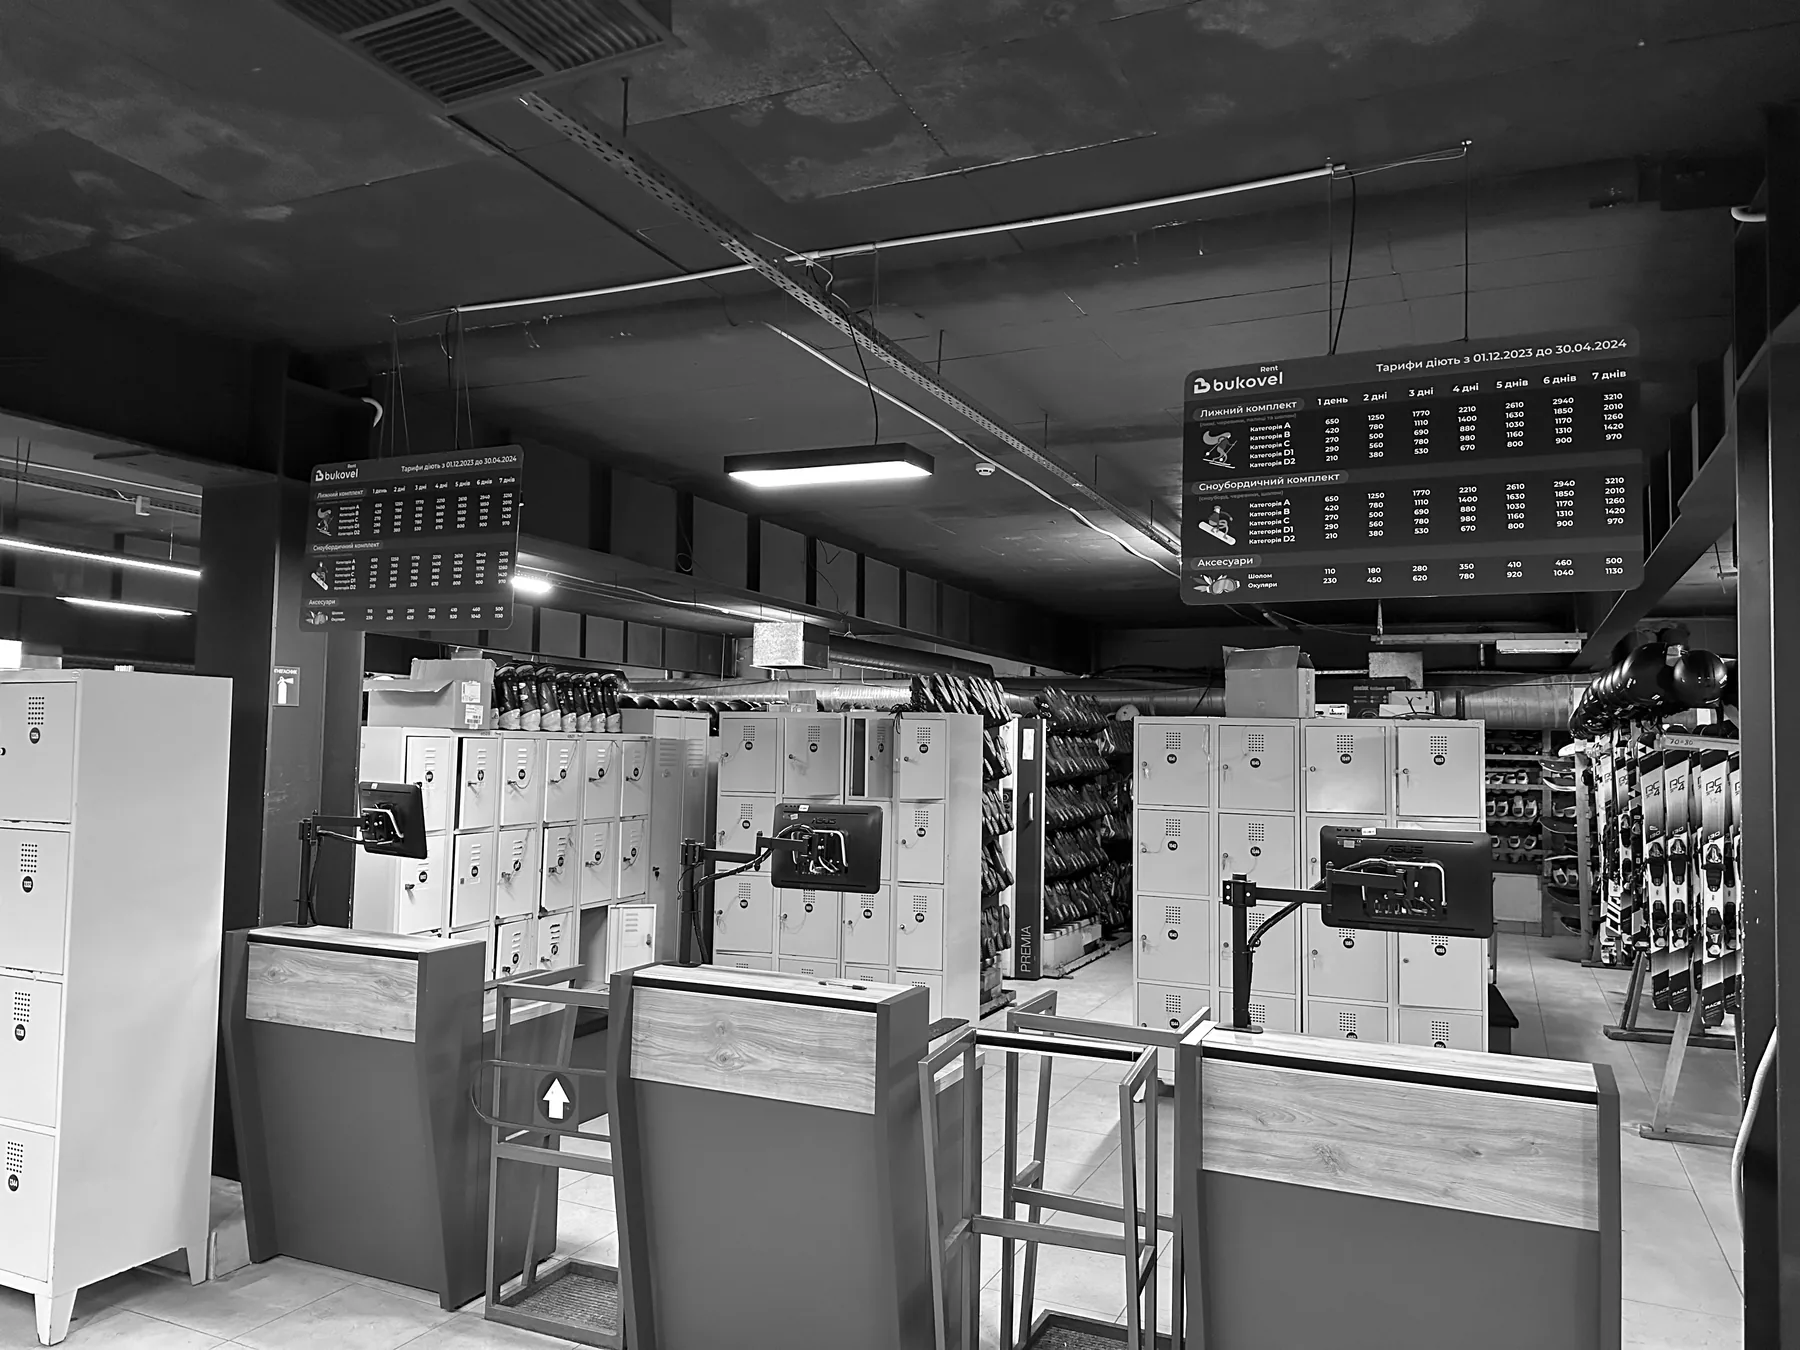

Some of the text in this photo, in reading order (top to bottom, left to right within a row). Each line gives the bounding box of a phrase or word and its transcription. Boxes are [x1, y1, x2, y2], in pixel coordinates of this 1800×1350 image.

[1376, 339, 1627, 373] Тарифи діють з 01.12.2023 до 30.04.2024
[1214, 372, 1283, 392] bukovel
[1324, 398, 1348, 406] день
[1371, 392, 1387, 401] дні
[1416, 387, 1433, 397] дні
[1453, 385, 1460, 393] 4
[1462, 383, 1479, 393] дні
[1497, 381, 1502, 389] 5
[1505, 379, 1529, 389] днів
[1543, 376, 1550, 385] 6
[1552, 374, 1577, 384] днів
[1592, 372, 1599, 380] 7
[1601, 369, 1627, 380] днів
[1200, 402, 1297, 418] Лижний комплект
[1412, 409, 1430, 417] 1770
[1458, 405, 1477, 413] 2210
[1505, 401, 1524, 409] 2610
[1552, 397, 1574, 405] 2940
[1603, 393, 1623, 401] 3210
[1457, 415, 1477, 423] 1400
[1505, 411, 1524, 419] 1630
[1553, 407, 1573, 415] 1850
[1603, 403, 1624, 411] 2010
[1325, 445, 1339, 453] 290
[1459, 434, 1476, 442] 980
[1506, 430, 1524, 438] 1160
[1555, 426, 1573, 434] 1310
[1369, 432, 1384, 440] 500
[1413, 428, 1429, 436] 690
[1326, 454, 1339, 462] 210
[1414, 447, 1429, 455] 530
[1507, 440, 1524, 448] 800
[1555, 436, 1572, 444] 900
[1605, 433, 1622, 441] 970
[446, 460, 474, 468] 01.12.2023
[484, 455, 517, 464] 30.04.2024
[325, 468, 358, 480] bukovel
[1199, 473, 1340, 492] Сноубордичний комплект
[1506, 483, 1525, 491] 2610
[1553, 480, 1576, 488] 2940
[1605, 477, 1625, 485] 3210
[1368, 501, 1384, 509] 780
[1605, 487, 1625, 495] 2010
[1460, 505, 1476, 513] 880
[1506, 502, 1526, 510] 1030
[1605, 497, 1625, 505] 1260
[1368, 520, 1384, 528] 560
[1507, 512, 1525, 520] 1160
[1605, 507, 1626, 515] 1420
[1507, 522, 1525, 530] 800
[1607, 517, 1624, 525] 970
[1198, 557, 1254, 567] Аксесуари
[1605, 557, 1623, 565] 500
[1412, 574, 1428, 582] 620
[1458, 572, 1475, 580] 780
[1553, 569, 1574, 577] 1040
[1605, 567, 1624, 575] 1130
[1384, 845, 1424, 855] ASUS
[1021, 926, 1031, 972] PREMIA
[1672, 986, 1687, 996] RACE
[1705, 1000, 1721, 1010] RACE
